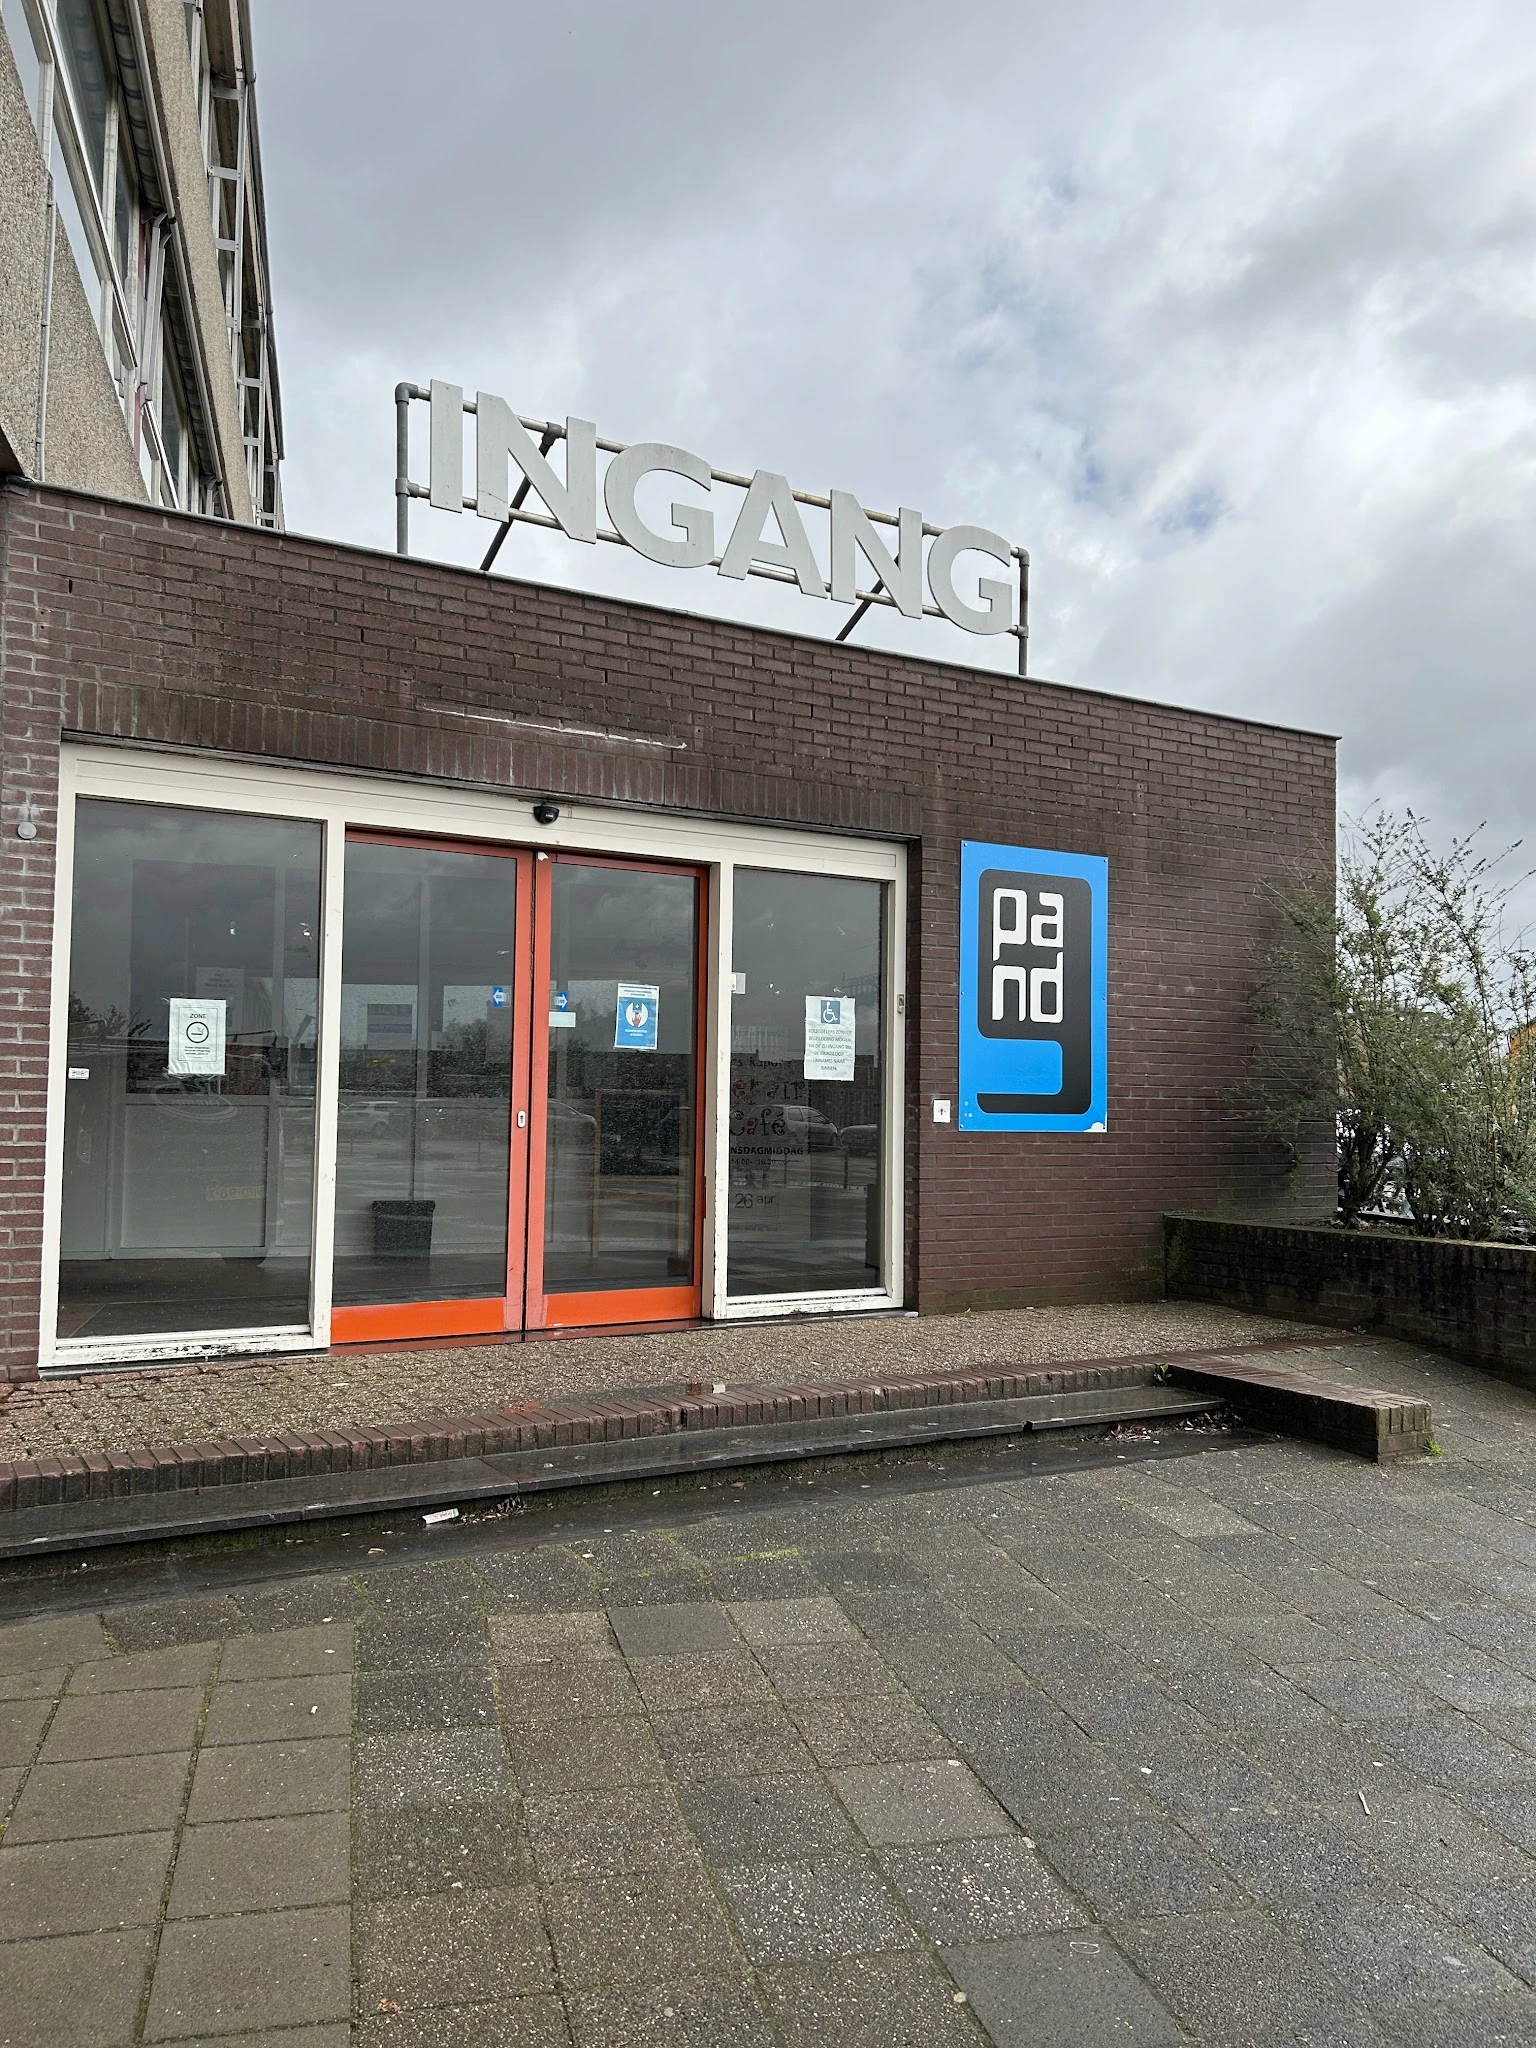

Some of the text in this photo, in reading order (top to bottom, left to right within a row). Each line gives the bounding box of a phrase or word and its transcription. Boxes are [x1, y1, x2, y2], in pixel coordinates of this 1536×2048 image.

[429, 379, 1013, 635] INGANG
[729, 1108, 786, 1137] Café
[734, 1193, 776, 1208] 26 apr
